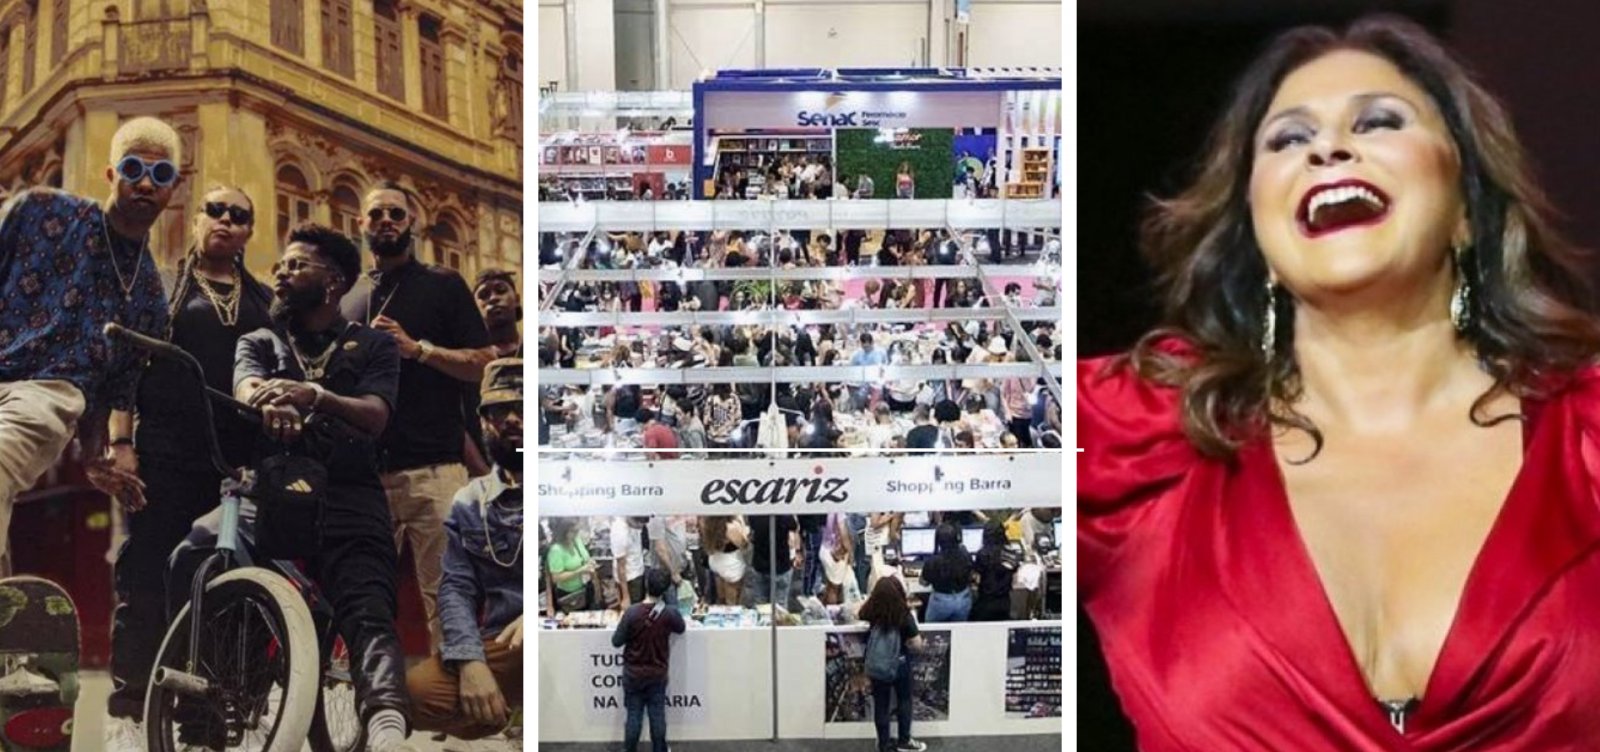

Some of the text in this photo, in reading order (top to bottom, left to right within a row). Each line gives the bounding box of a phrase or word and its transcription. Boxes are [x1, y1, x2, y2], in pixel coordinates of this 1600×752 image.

[798, 111, 857, 126] Senac
[621, 483, 664, 496] Barra
[700, 465, 850, 504] escariz
[886, 478, 1012, 494] Shopng Barra
[593, 695, 618, 709] NA
